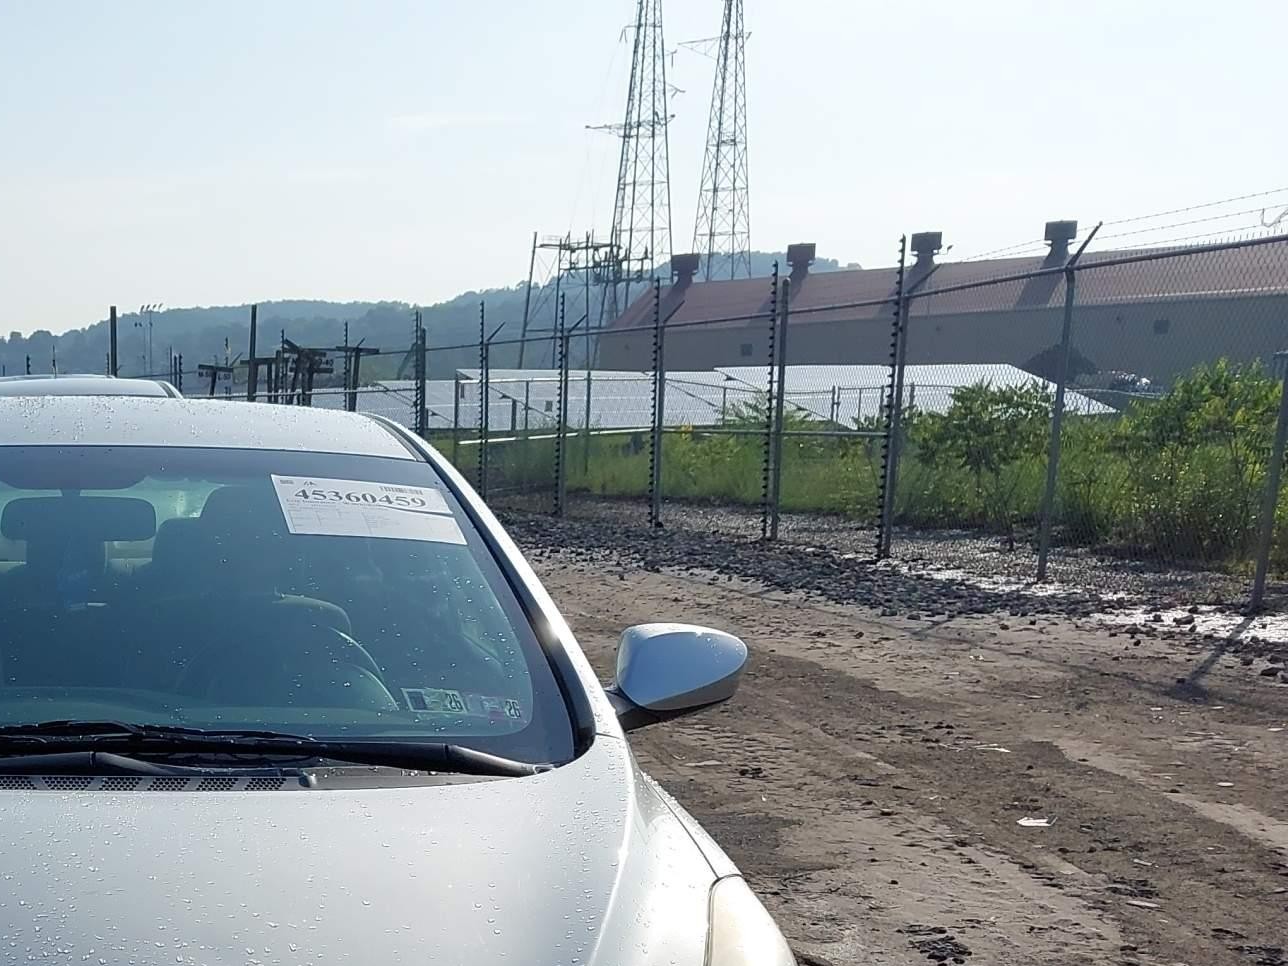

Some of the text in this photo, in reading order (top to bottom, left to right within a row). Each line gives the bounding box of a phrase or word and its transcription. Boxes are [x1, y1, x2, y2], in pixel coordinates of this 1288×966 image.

[294, 488, 426, 508] 45360459
[445, 693, 464, 713] 26
[505, 700, 521, 718] 26
